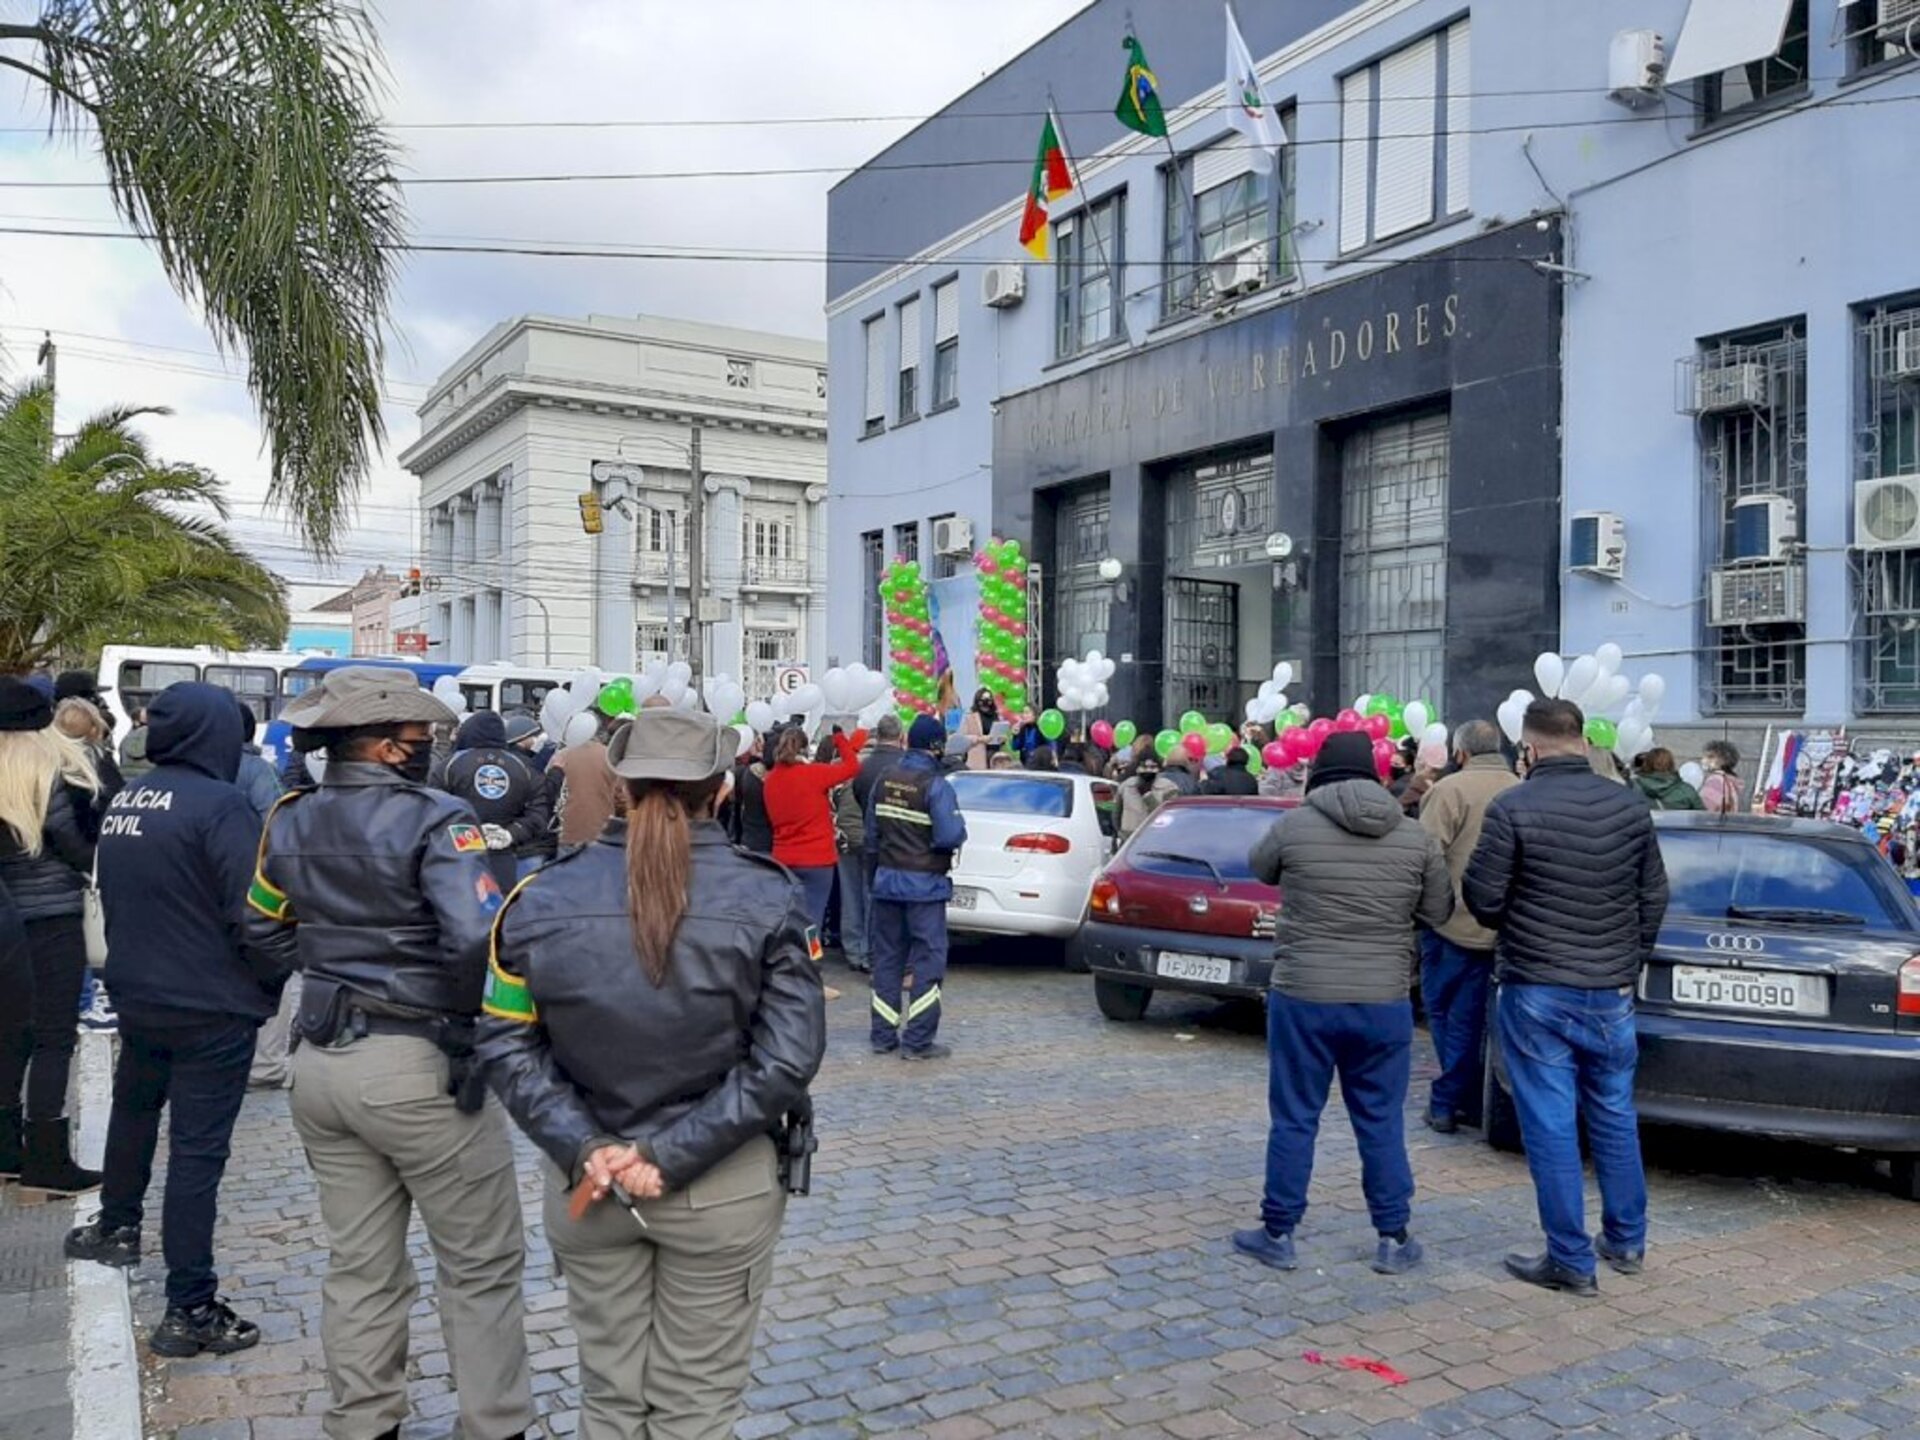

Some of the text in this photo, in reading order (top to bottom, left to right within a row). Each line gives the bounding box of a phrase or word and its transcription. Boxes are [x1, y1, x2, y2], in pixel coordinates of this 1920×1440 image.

[1152, 376, 1184, 419] DE
[1207, 294, 1459, 401] VEREADORES
[787, 674, 798, 690] E
[111, 786, 174, 811] OLÍCIA
[101, 815, 143, 836] CIVIL
